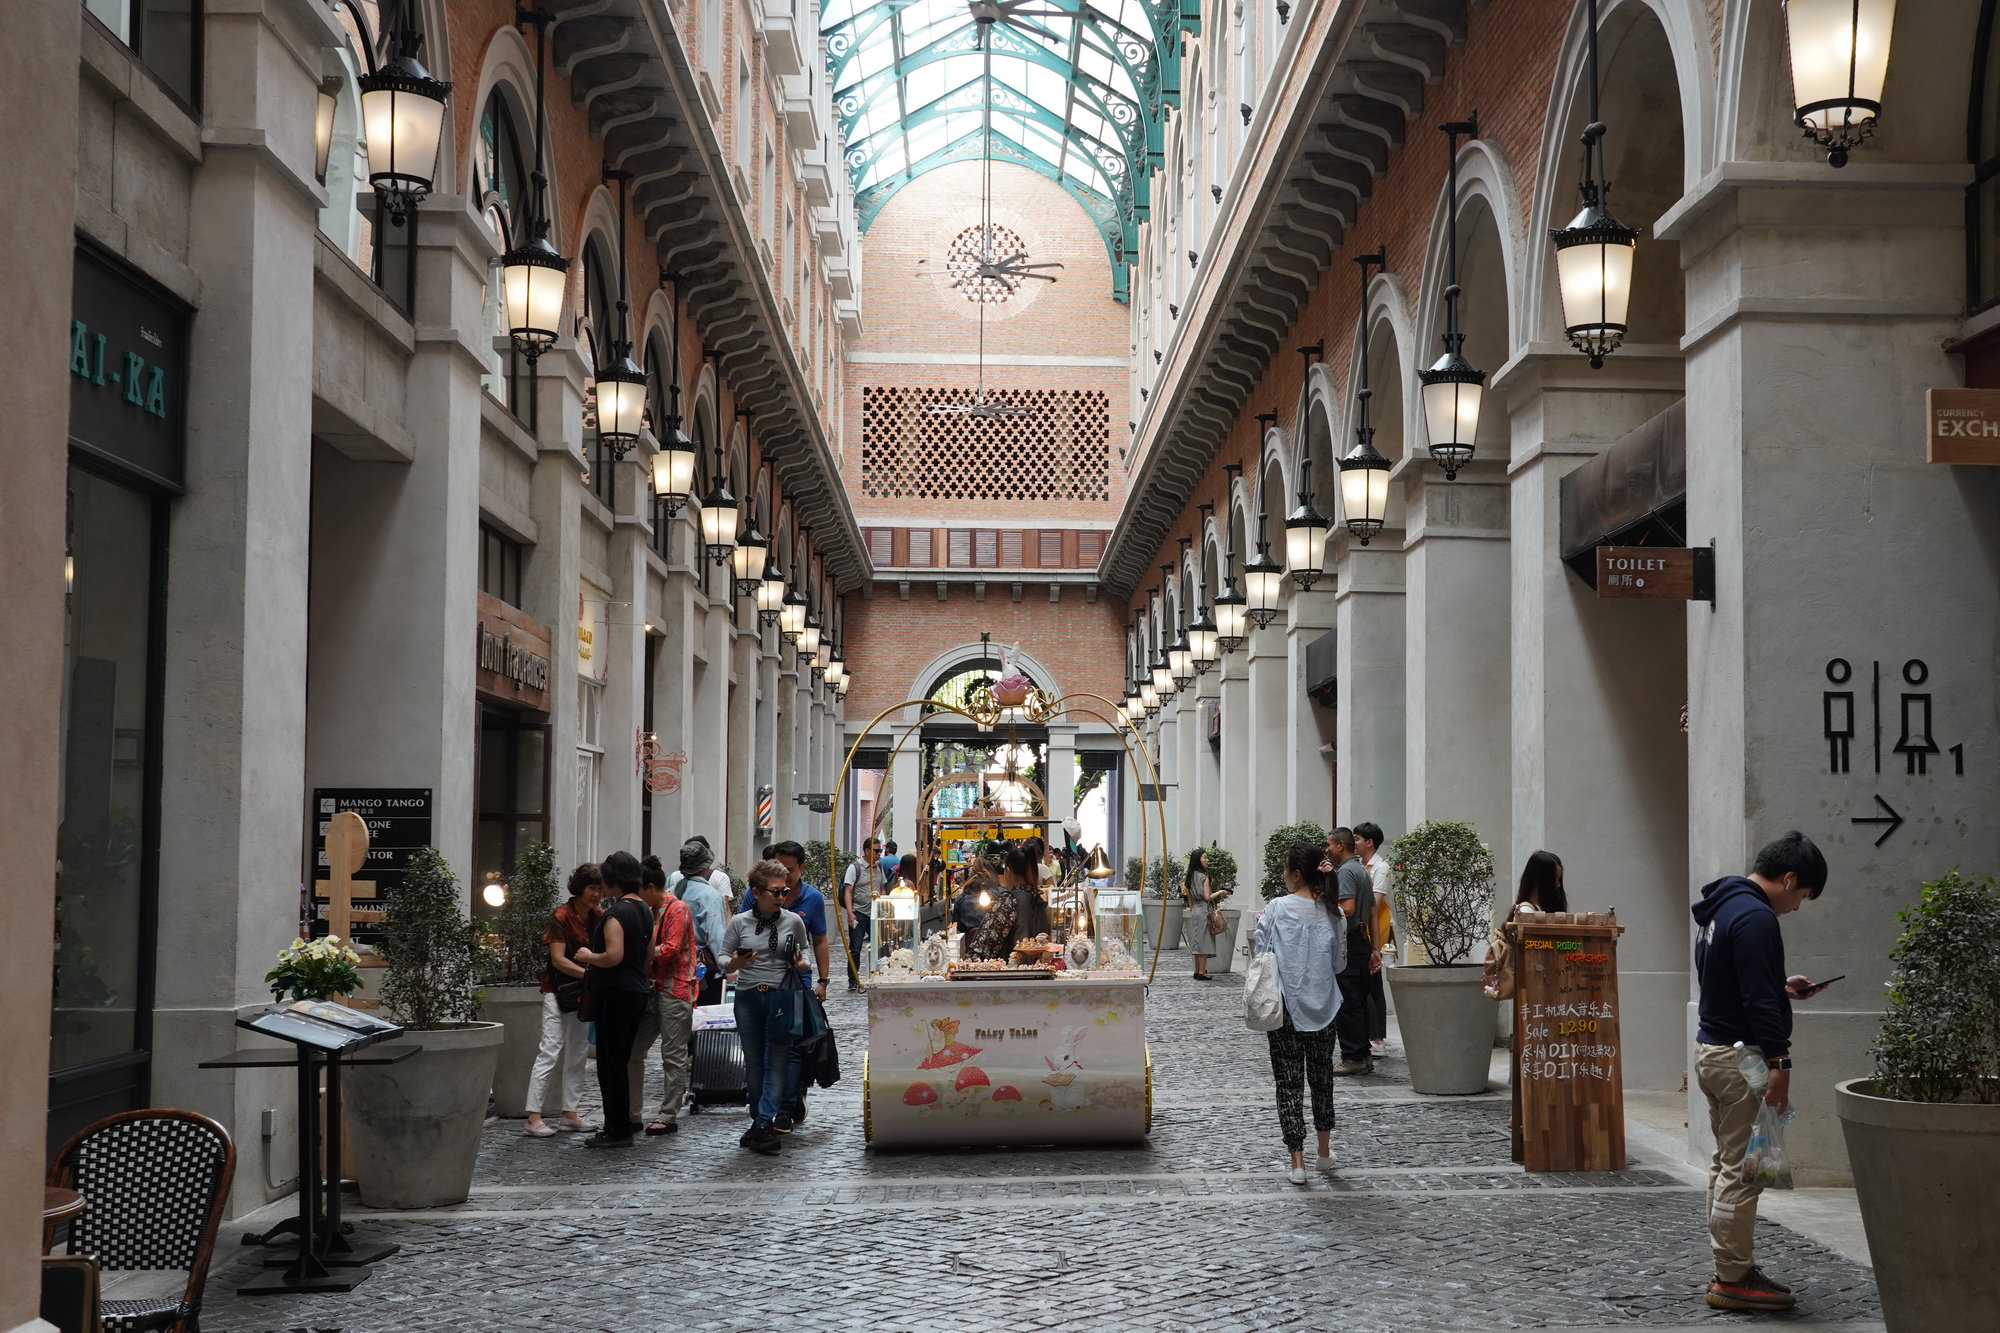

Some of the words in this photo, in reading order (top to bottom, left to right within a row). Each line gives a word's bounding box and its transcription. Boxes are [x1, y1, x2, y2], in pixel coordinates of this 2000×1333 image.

[1936, 408, 1985, 418] CURRENCY
[1937, 419, 2000, 438] EXCH
[1606, 558, 1666, 571] TOILET
[1948, 742, 1964, 775] 1
[340, 799, 382, 808] MANGO
[386, 799, 425, 808] TANGO
[368, 820, 392, 829] ONE
[366, 851, 394, 860] ATOR
[1524, 940, 1554, 950] SPECIAL
[1556, 942, 1583, 951] ROBOT
[1563, 953, 1609, 963] WORKSHOP
[1520, 1001, 1614, 1020] 手工机器人音乐盒
[1525, 1022, 1549, 1041] Sale
